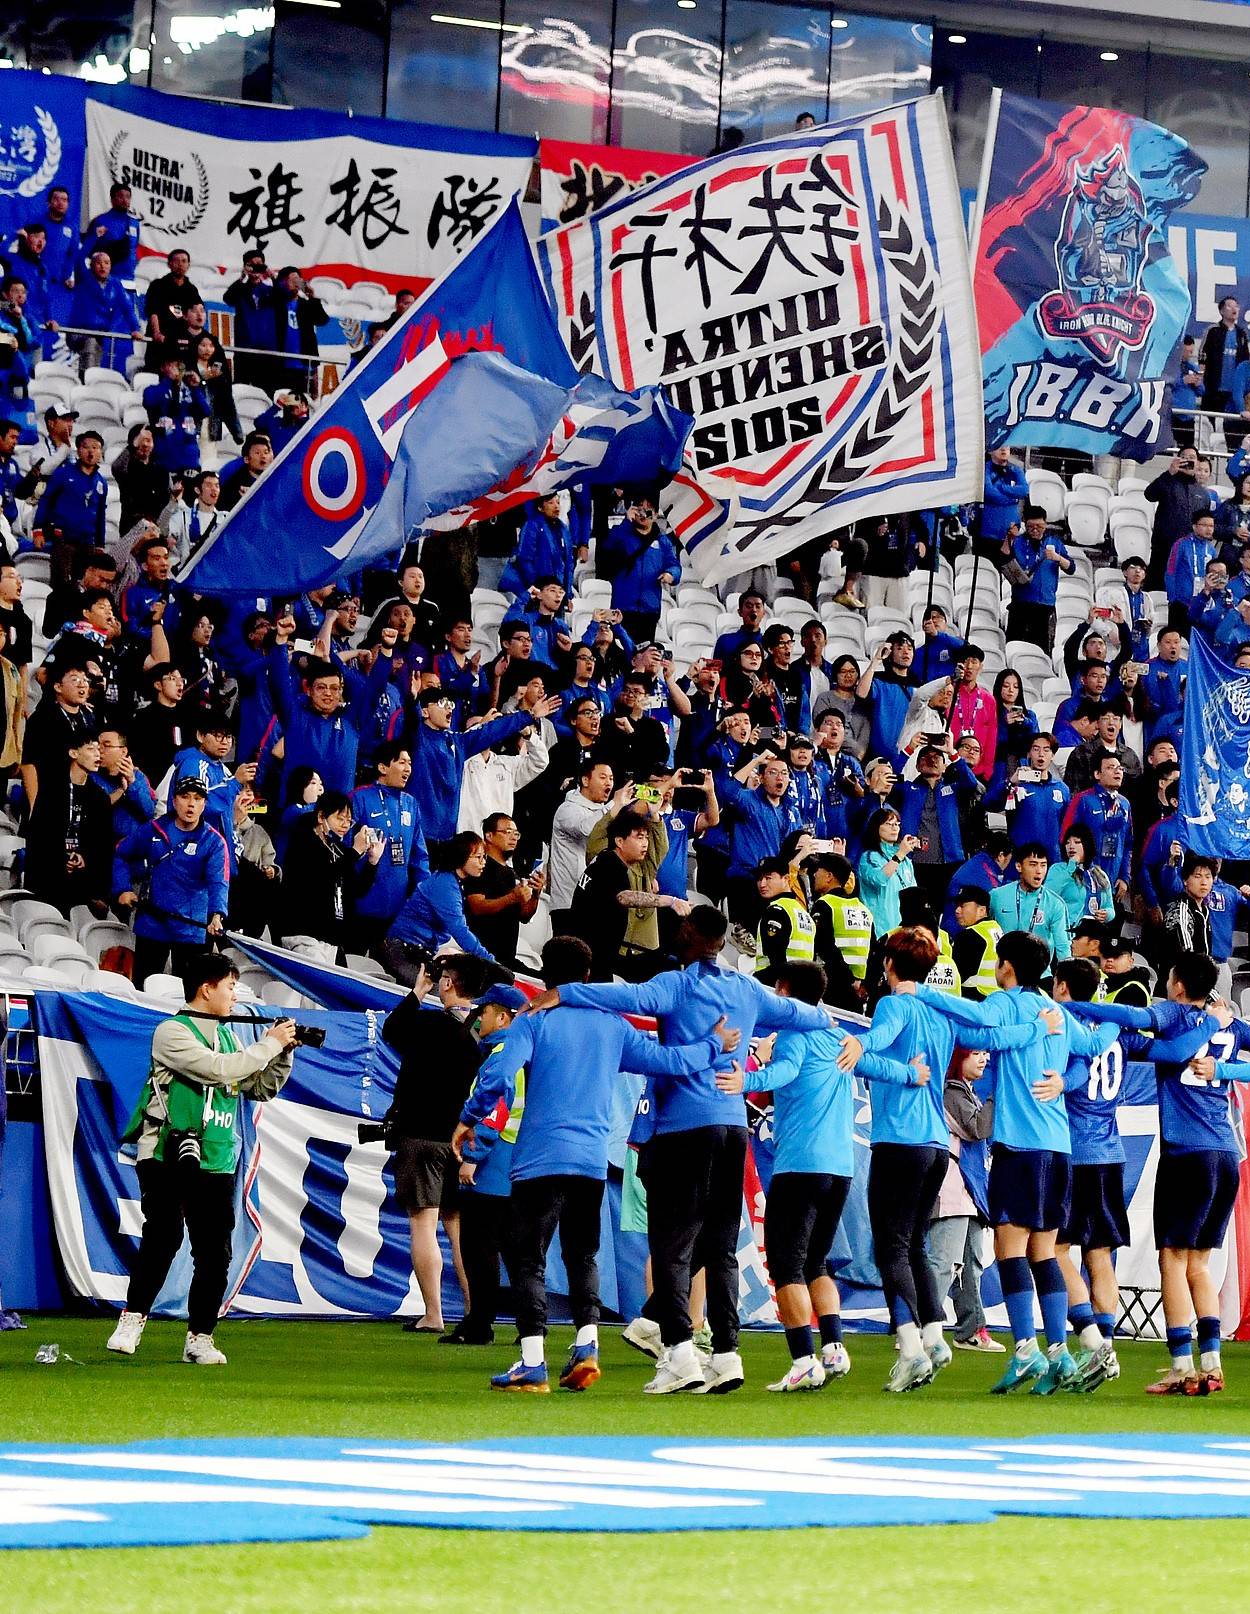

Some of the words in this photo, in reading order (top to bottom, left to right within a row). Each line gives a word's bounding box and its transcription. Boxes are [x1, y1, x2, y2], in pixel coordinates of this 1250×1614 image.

[121, 165, 194, 205] SHENHUA
[148, 197, 166, 219] 12
[1059, 318, 1081, 330] IRON
[927, 976, 954, 986] BAOAN
[1088, 1040, 1123, 1101] 10
